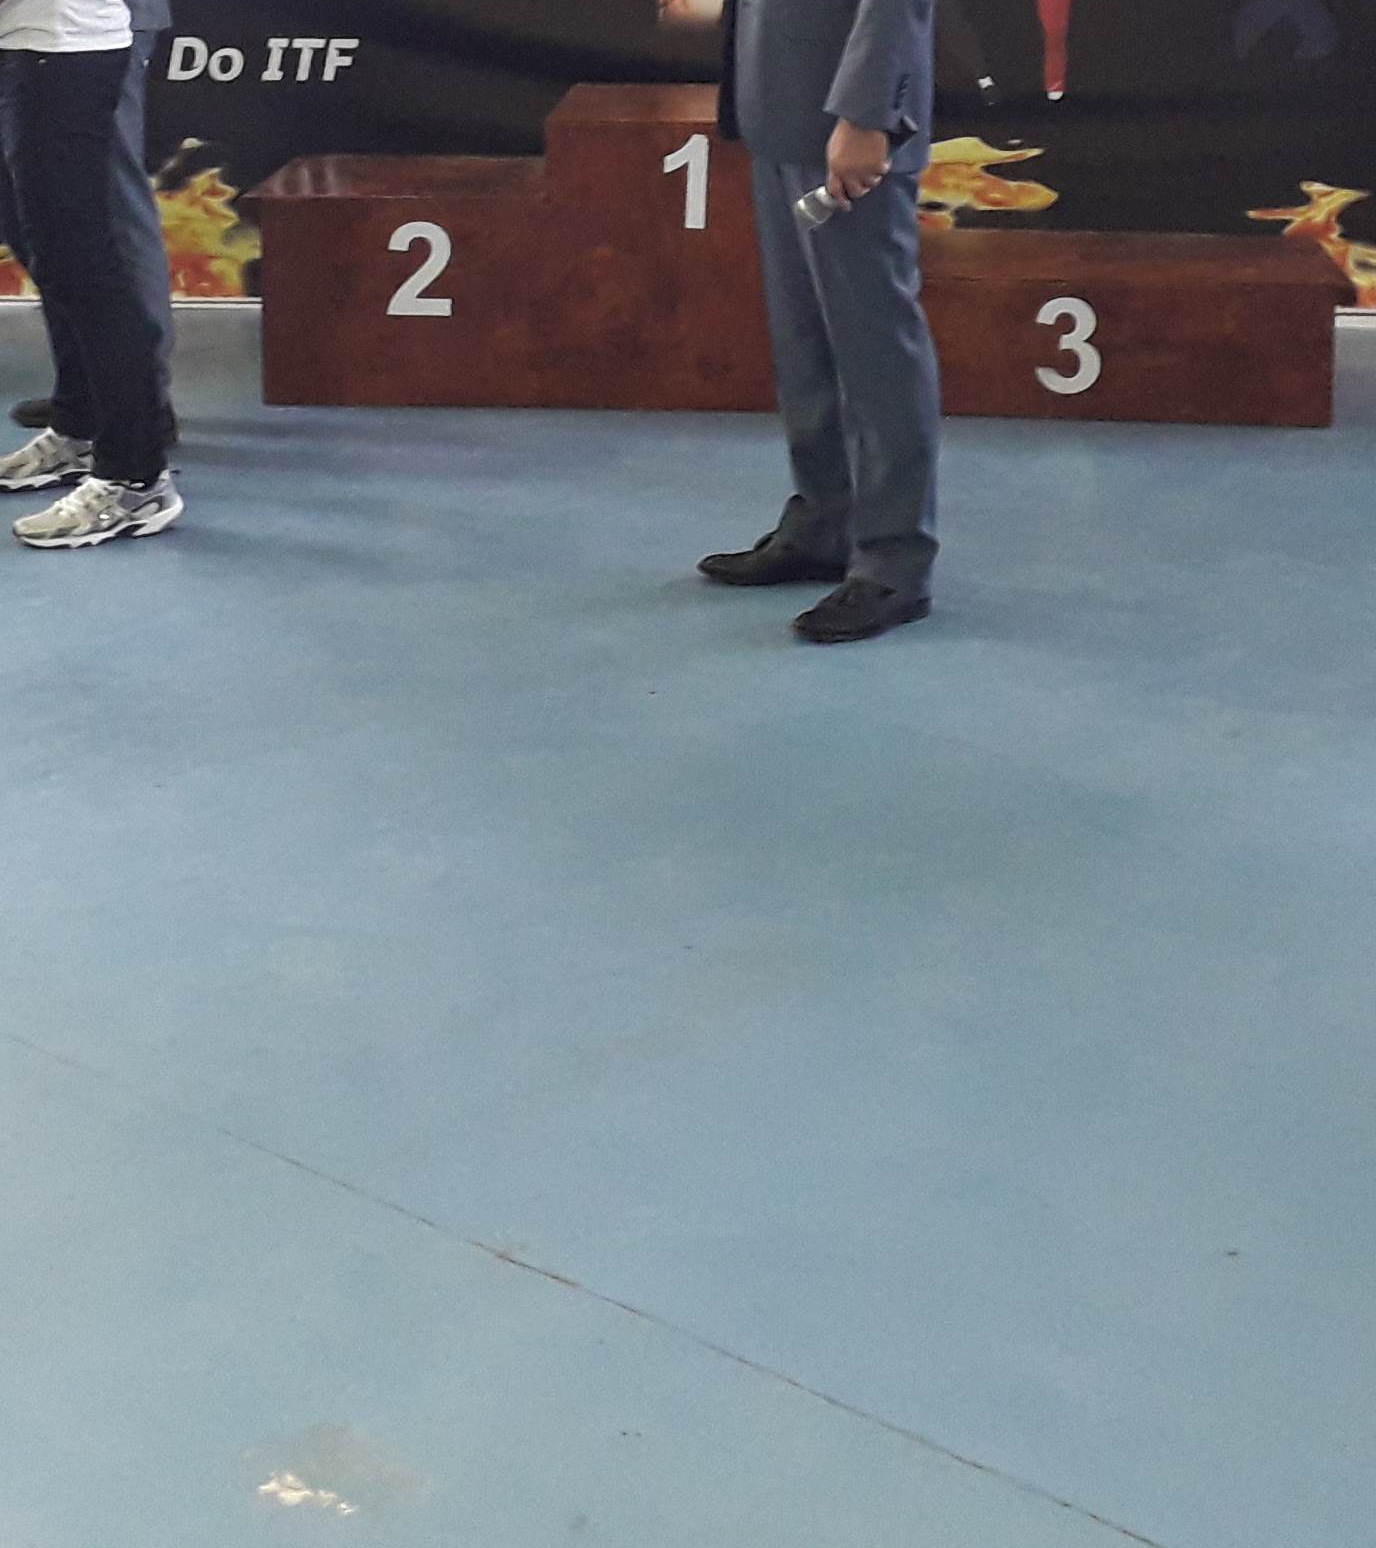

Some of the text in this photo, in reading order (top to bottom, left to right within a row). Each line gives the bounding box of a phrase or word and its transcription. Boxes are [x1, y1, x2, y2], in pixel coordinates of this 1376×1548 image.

[167, 36, 245, 82] Do
[261, 37, 360, 82] ITF
[662, 132, 710, 230] 1
[385, 220, 453, 318] 2
[1035, 296, 1102, 395] 3
